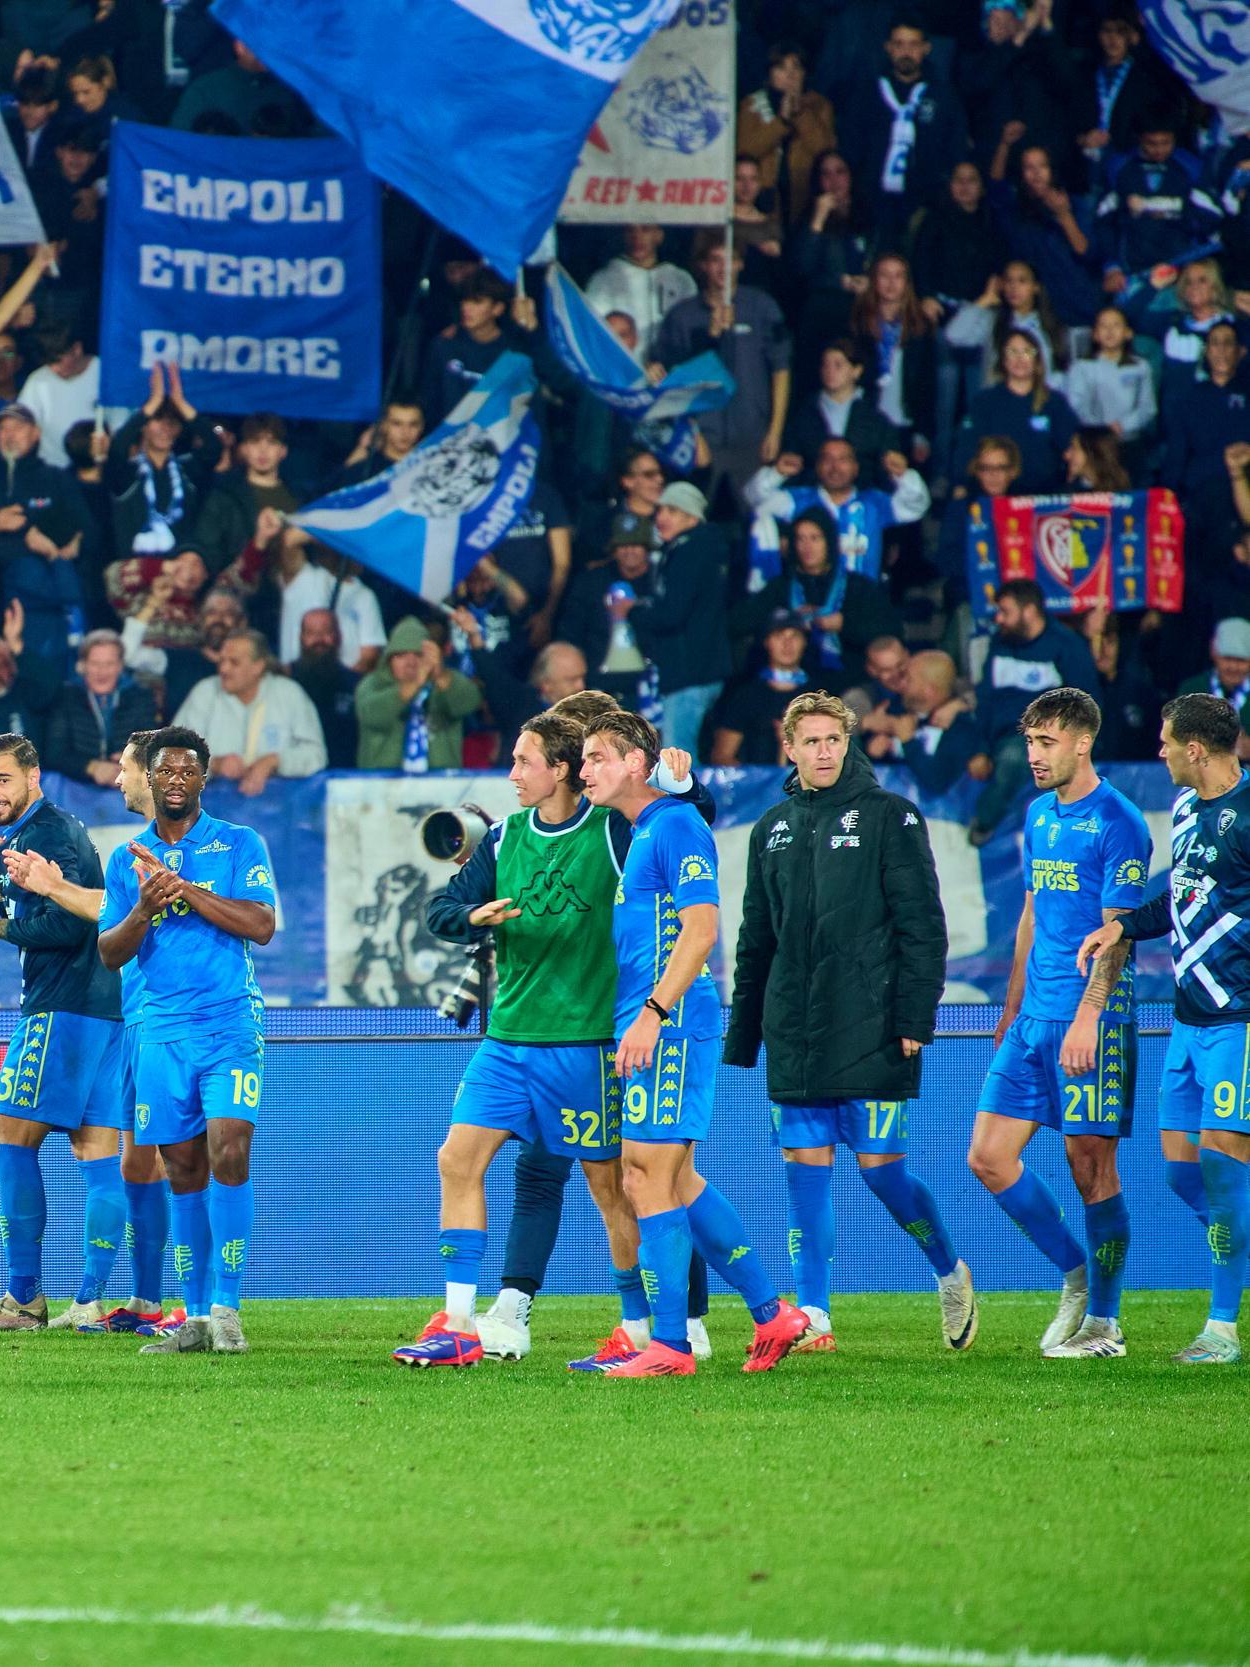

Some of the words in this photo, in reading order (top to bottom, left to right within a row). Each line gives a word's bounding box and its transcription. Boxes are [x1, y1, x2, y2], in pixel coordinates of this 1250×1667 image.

[141, 168, 344, 223] EMPOLI
[584, 176, 634, 205] RED
[662, 177, 730, 205] ANTS
[139, 244, 345, 297] ETERNO
[139, 329, 342, 379] AMORE
[466, 443, 538, 550] EMPOLI
[830, 838, 861, 850] gross
[1032, 869, 1081, 896] gross
[1173, 883, 1209, 905] gross
[230, 1069, 260, 1108] 19
[1064, 1084, 1096, 1122] 21
[1213, 1080, 1237, 1118] 9
[560, 1107, 601, 1148] 32
[865, 1101, 898, 1139] 17
